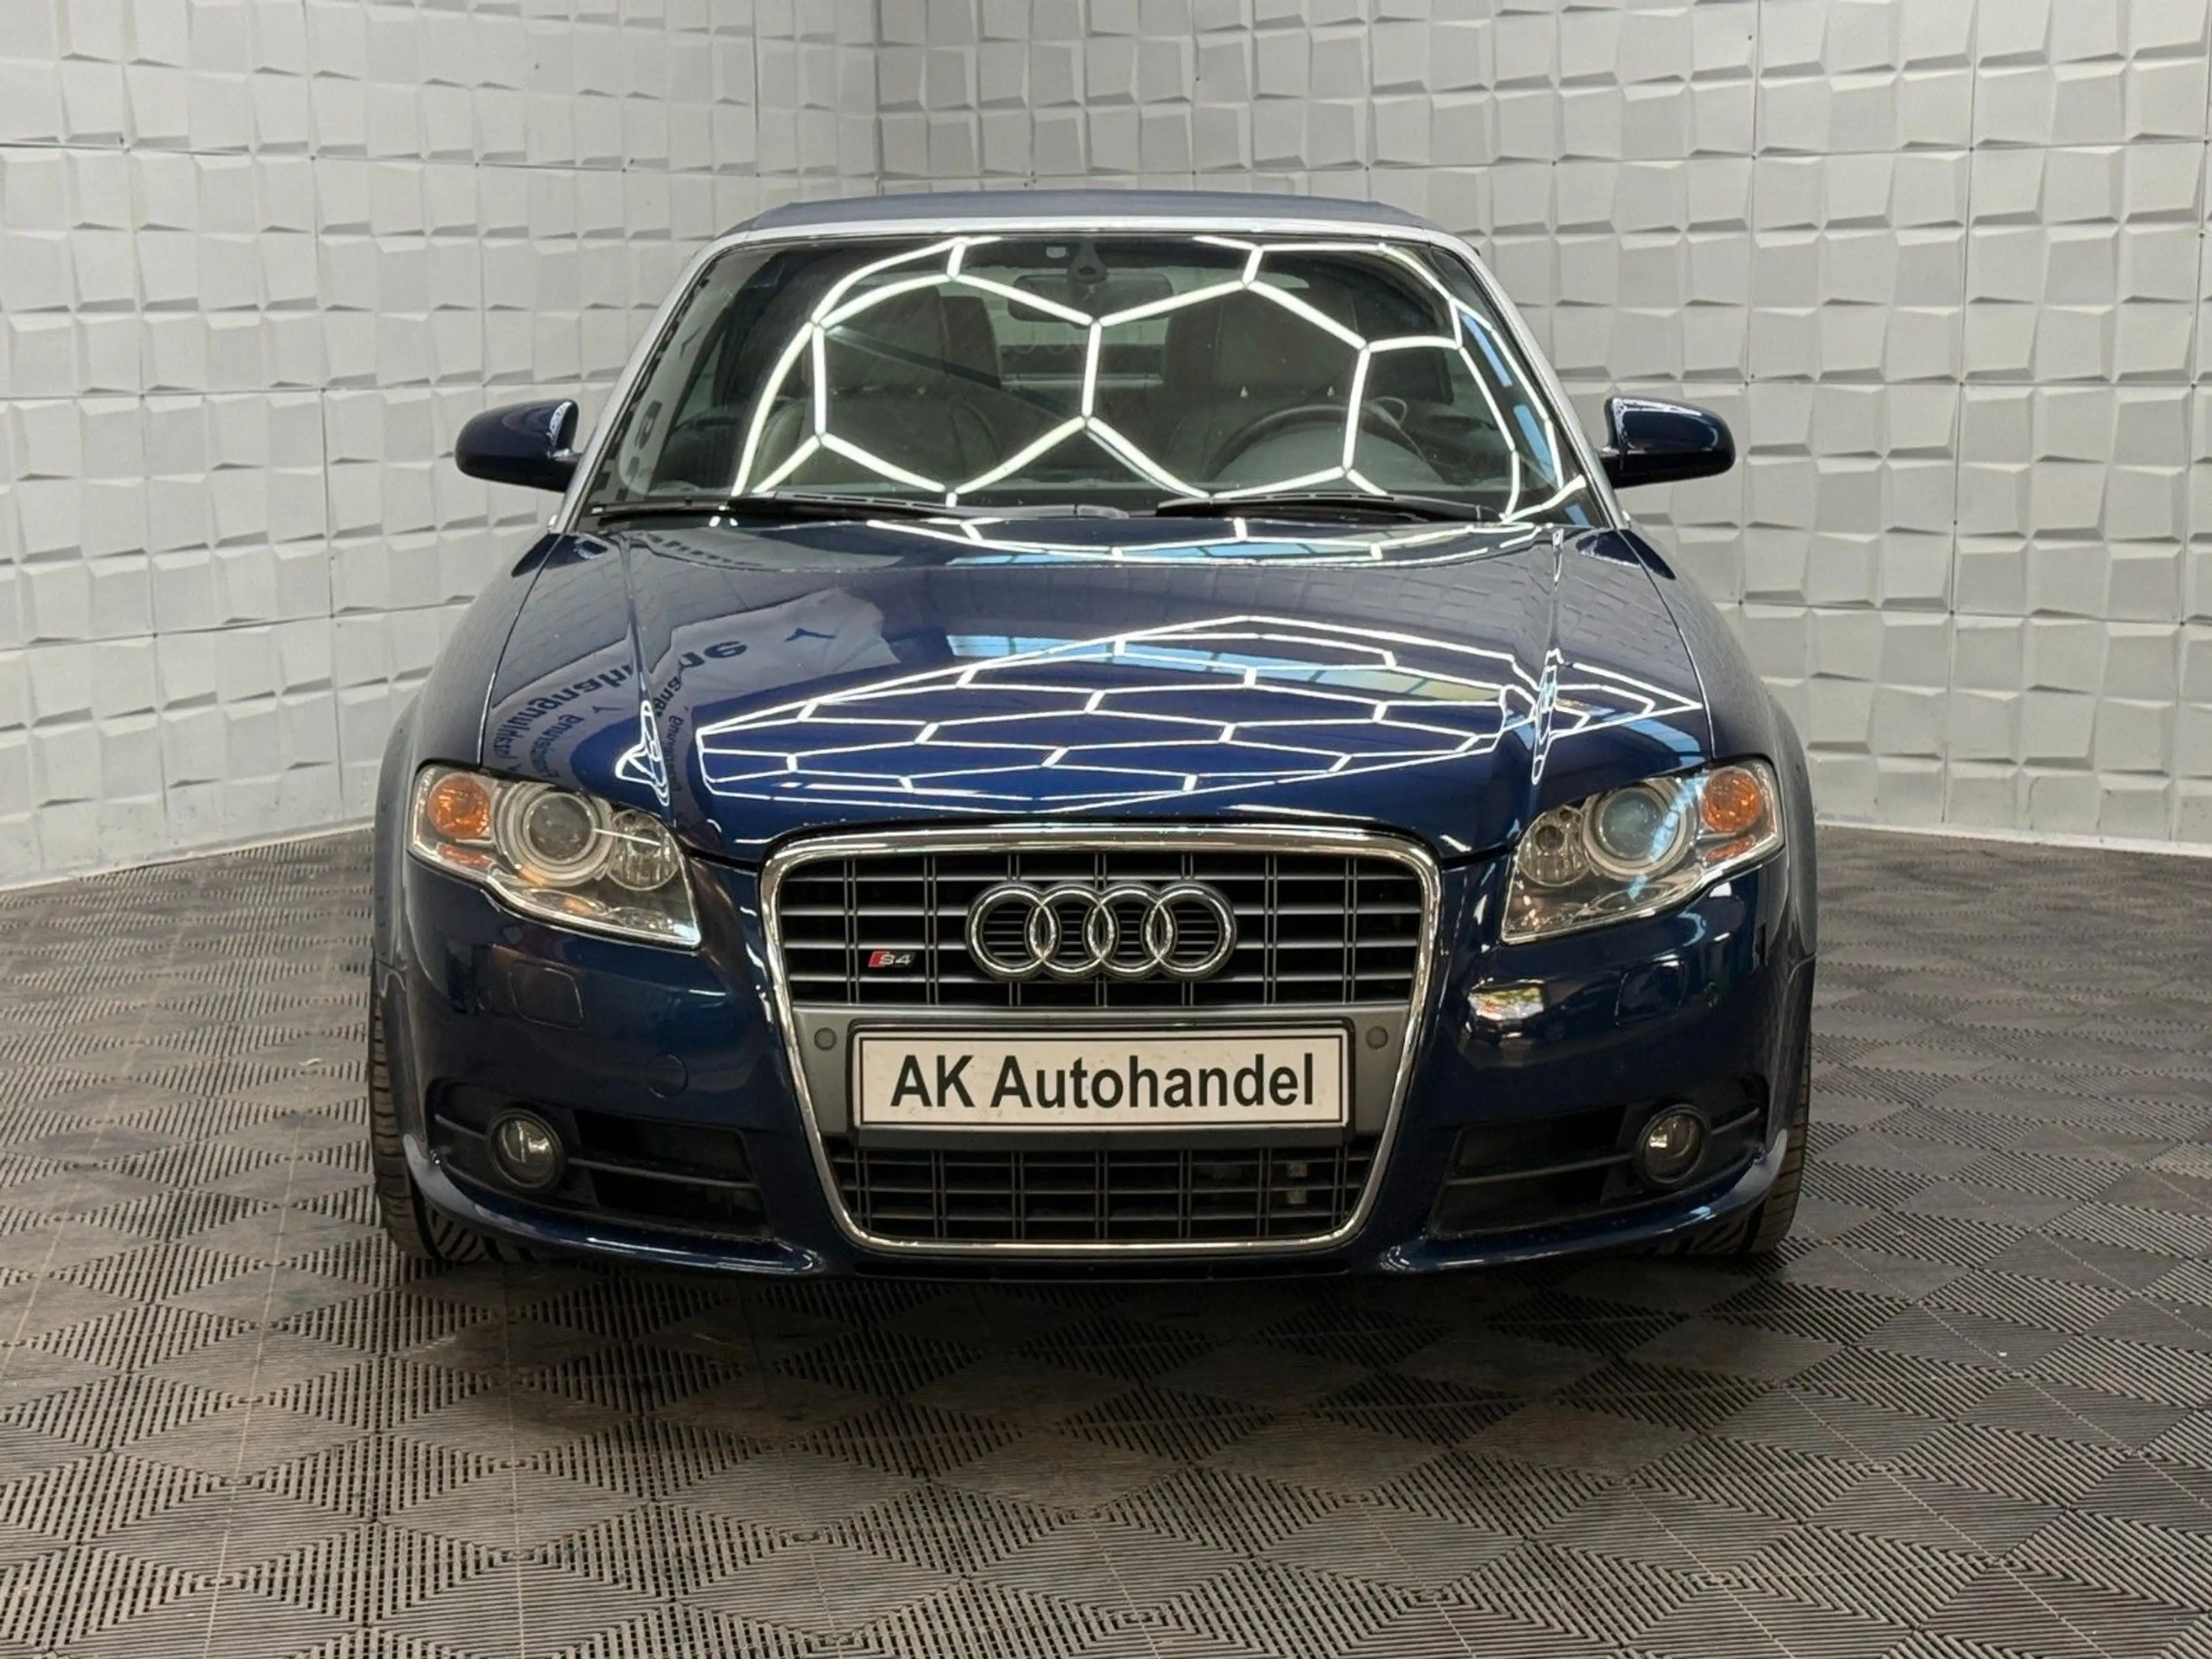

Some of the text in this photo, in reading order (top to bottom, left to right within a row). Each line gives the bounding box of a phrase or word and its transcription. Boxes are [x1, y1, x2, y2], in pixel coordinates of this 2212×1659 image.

[878, 953, 911, 966] S4
[890, 1052, 1313, 1108] AK Autohandel
